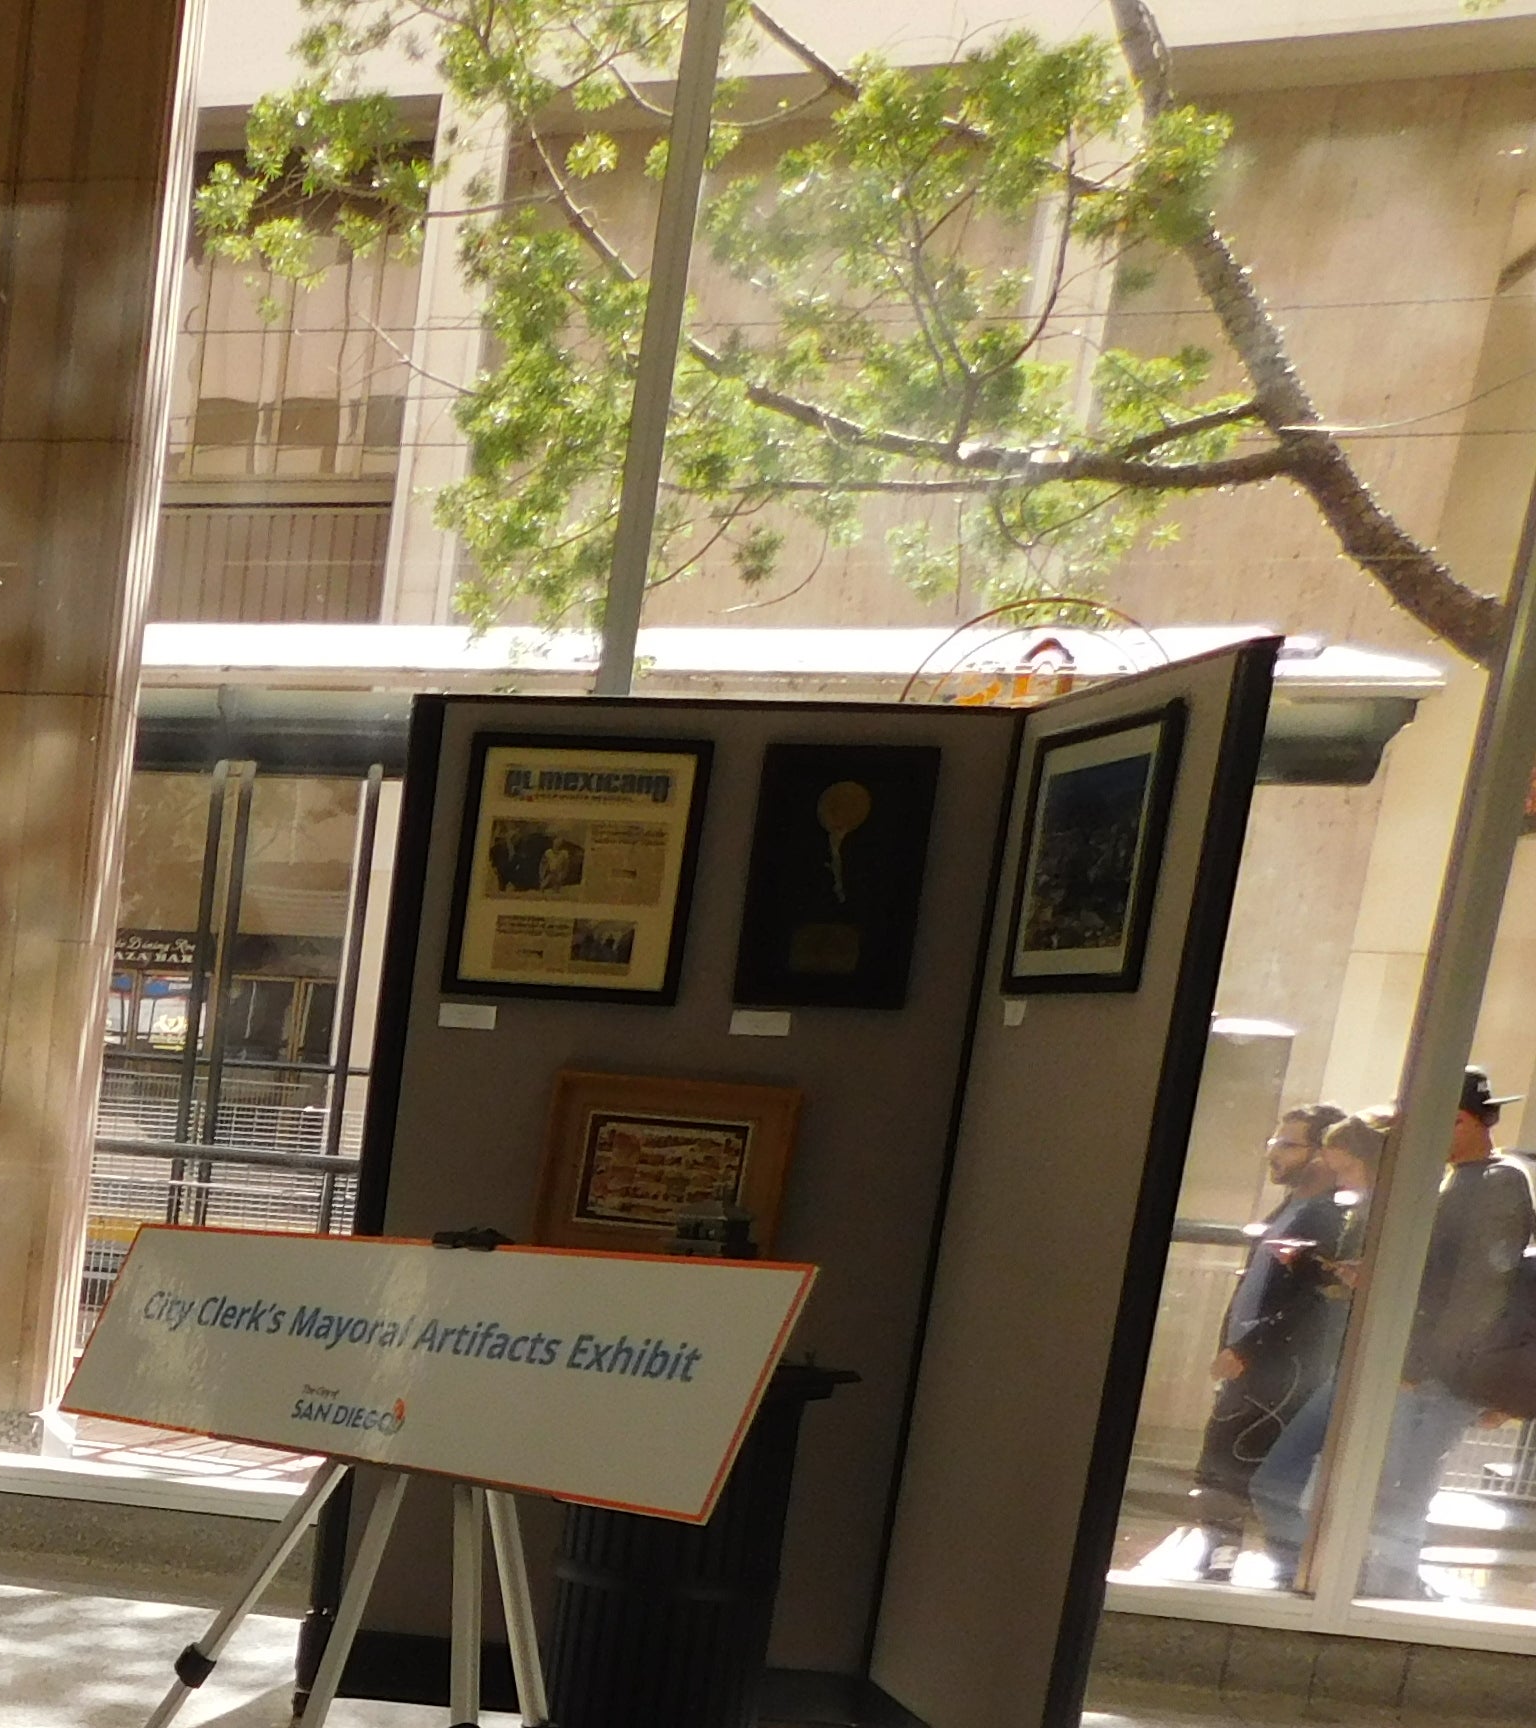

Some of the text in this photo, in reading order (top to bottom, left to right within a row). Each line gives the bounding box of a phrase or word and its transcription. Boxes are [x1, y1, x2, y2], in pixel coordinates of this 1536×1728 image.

[125, 936, 169, 951] Dining
[154, 953, 194, 963] BAR
[144, 1291, 703, 1383] City Clerk's Mayoral Artifacts Exhibit
[291, 1399, 406, 1436] SAN DIEGO
